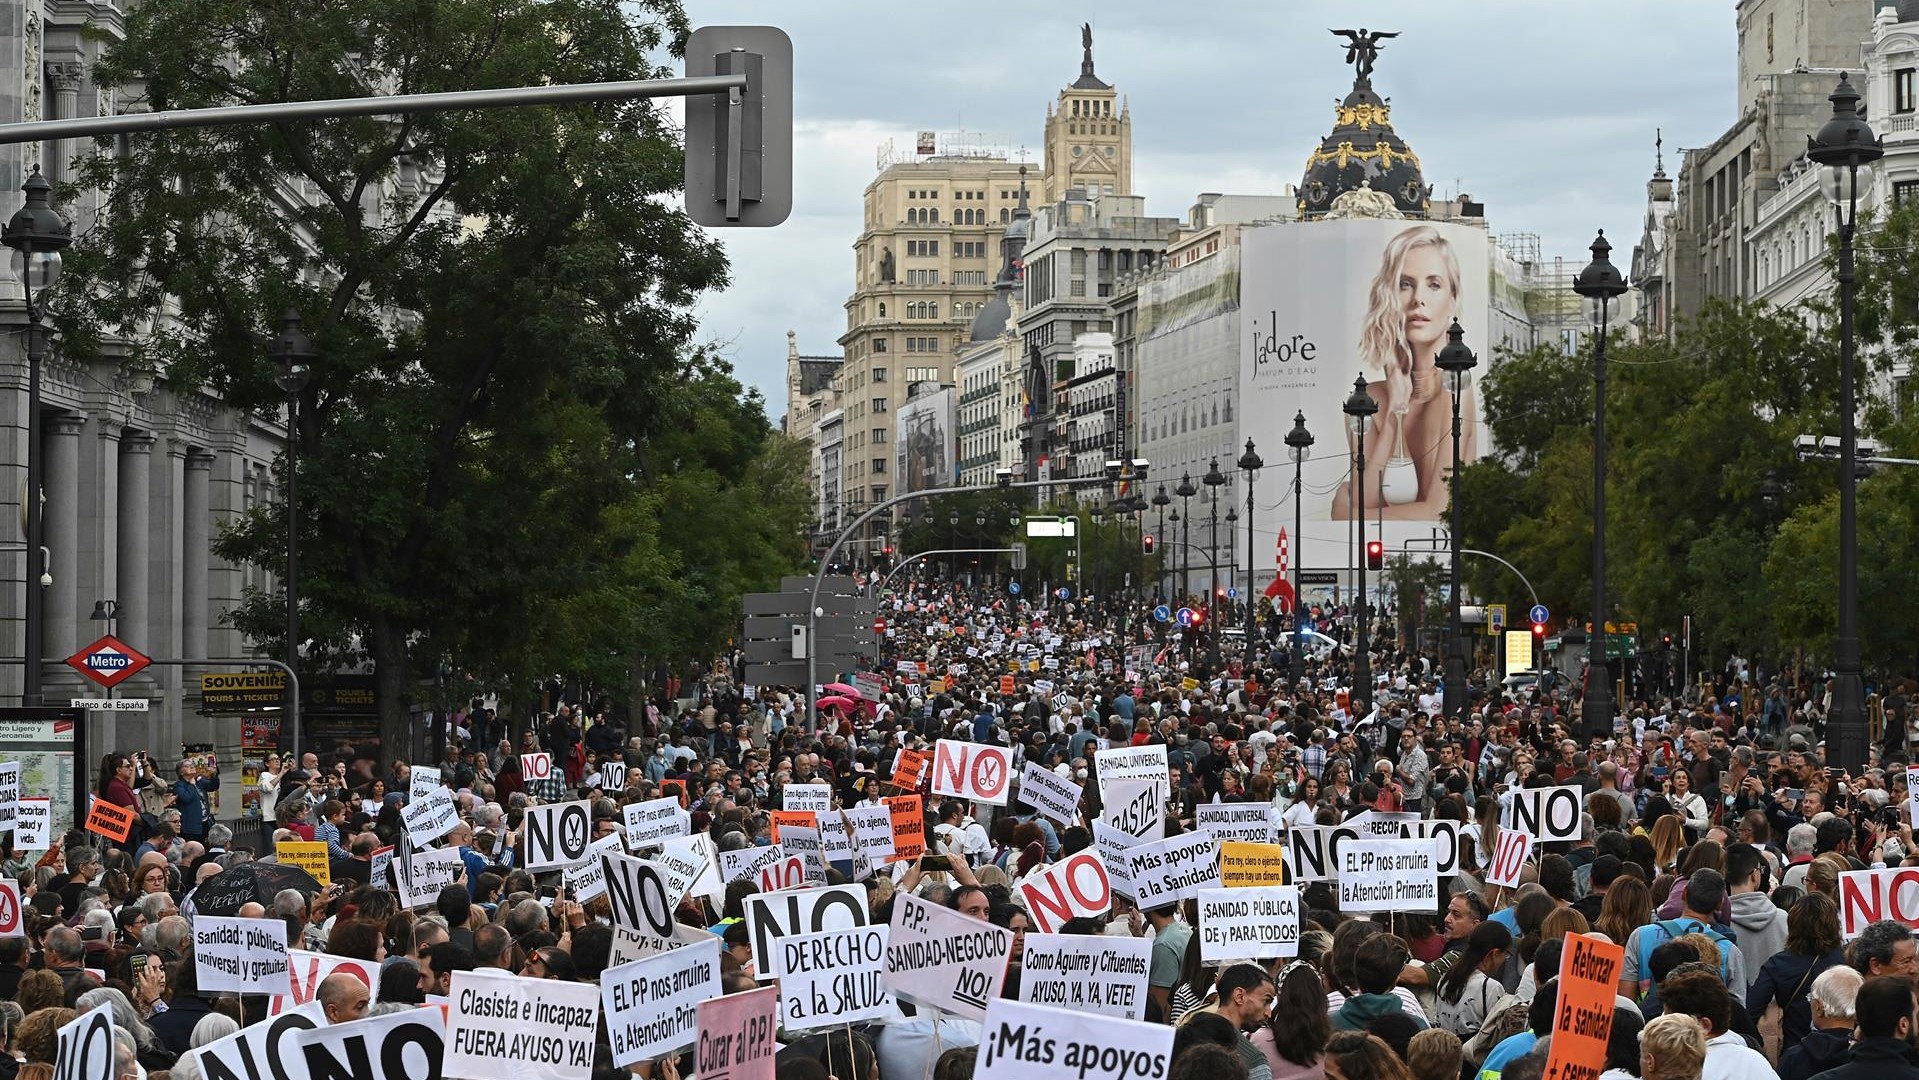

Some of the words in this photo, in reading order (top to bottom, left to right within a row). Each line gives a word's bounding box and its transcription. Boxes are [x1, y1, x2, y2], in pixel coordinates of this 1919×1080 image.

[1252, 310, 1317, 381] j'adore
[91, 656, 126, 668] Metro
[205, 675, 286, 688] SOUVENIRS
[907, 685, 920, 696] NO
[75, 701, 99, 709] Banco
[102, 701, 113, 709] de
[116, 701, 144, 710] España
[205, 695, 233, 703] TOURS
[244, 694, 279, 702] TICKETS
[1053, 693, 1068, 710] NO
[12, 725, 35, 733] Ligero
[244, 720, 279, 728] MADRID
[523, 754, 550, 779] NO
[935, 743, 1008, 799] NO
[1130, 753, 1166, 769] UNIVERSAL,
[604, 763, 624, 790] NO
[1028, 769, 1045, 786] ¡Más
[1045, 775, 1076, 804] sanitarios,
[785, 789, 798, 798] Como
[798, 789, 810, 800] Aguirre
[1023, 787, 1039, 802] muy
[1039, 794, 1074, 820] necesarios!
[18, 820, 36, 831] salud
[90, 815, 99, 826] TU
[409, 817, 435, 833] universal
[630, 813, 638, 825] EL
[638, 811, 646, 823] PP
[647, 811, 658, 822] nos
[660, 805, 676, 820] arruina
[858, 817, 865, 829] lo
[867, 816, 890, 831] ajeno,
[1231, 810, 1268, 823] UNIVERSAL,
[1512, 788, 1578, 838] NO
[20, 834, 37, 845] vida.
[528, 804, 588, 865] NO
[630, 832, 636, 843] la
[636, 827, 660, 842] Atención
[894, 821, 922, 836] sanidad
[1099, 835, 1108, 847] La
[1240, 828, 1268, 841] TODOS!
[1371, 821, 1399, 835] RECOR
[825, 840, 836, 851] ella
[836, 841, 847, 851] nos
[870, 837, 892, 848] cueros.
[669, 857, 697, 878] ATENCIÓN
[727, 855, 742, 869] P.P.:
[1130, 853, 1161, 879] ¡Más
[1164, 841, 1211, 868] apoyos
[1224, 855, 1235, 865] Para
[1235, 857, 1244, 868] rey,
[1246, 856, 1257, 866] clero
[1262, 856, 1281, 868] ejército
[1347, 852, 1359, 873] EL
[1361, 852, 1375, 872] PP
[1376, 854, 1394, 872] nos
[1396, 851, 1429, 871] arruina
[1487, 833, 1527, 884] NO
[422, 882, 439, 895] sisan
[574, 875, 594, 892] FUERA
[1139, 887, 1148, 899] a
[1151, 880, 1163, 895] la
[1163, 862, 1220, 892] Sanidad!
[1224, 872, 1245, 883] siempre
[1246, 871, 1255, 883] hay
[1255, 873, 1262, 881] un
[1263, 871, 1281, 881] dinero.
[601, 855, 673, 938] NO
[1021, 854, 1111, 934] NO
[1342, 887, 1350, 903] la
[1352, 882, 1394, 903] Atención
[1396, 881, 1436, 901] Primaria.
[902, 902, 930, 934] P.P.:
[1204, 902, 1249, 923] ¡SANIDAD
[1253, 896, 1296, 918] PÚBLICA,
[198, 925, 243, 946] sanidad:
[247, 927, 288, 955] pública,
[753, 891, 866, 975] NO
[1205, 927, 1220, 943] DE
[1222, 932, 1228, 947] y
[1230, 925, 1258, 942] PARA
[1258, 924, 1298, 941] TODOS!
[786, 932, 883, 975] DERECHO
[887, 930, 1007, 973] SANIDAD-NEGOCIO
[1025, 948, 1054, 970] Como
[1054, 948, 1090, 977] Aguirre
[1091, 953, 1098, 977] y
[1100, 950, 1147, 978] Cifuentes,
[1571, 941, 1616, 985] Reforzar
[198, 952, 240, 975] universal
[242, 961, 249, 981] y
[252, 959, 288, 982] gratuita!
[614, 985, 630, 1013] EL
[632, 977, 648, 1007] PP
[652, 974, 671, 1001] nos
[673, 960, 710, 992] arruina
[789, 997, 806, 1019] a
[811, 980, 829, 1016] la
[832, 970, 890, 1016] SALUD.
[955, 966, 993, 1001] NO!
[1031, 981, 1067, 1007] AYUSO,
[1069, 981, 1084, 1007] YA,
[1087, 982, 1102, 1008] YA,
[1106, 983, 1136, 1007] VETE!
[460, 989, 518, 1020] Clasista
[522, 1001, 532, 1021] e
[535, 996, 595, 1033] incapaz,
[1559, 994, 1572, 1032] la
[1575, 1002, 1612, 1042] sanidad
[54, 1012, 112, 1080] NO
[614, 1029, 625, 1055] la
[627, 1012, 675, 1053] Atención
[700, 1029, 733, 1074] Curar
[736, 1021, 746, 1065] al
[749, 1014, 773, 1061] P.P.!
[303, 1023, 444, 1080] NO
[455, 1028, 506, 1058] FUERA
[509, 1033, 564, 1065] AYUSO
[568, 1040, 593, 1068] YA!
[985, 1022, 1056, 1068] ¡Más
[1064, 1041, 1166, 1080] apoyos
